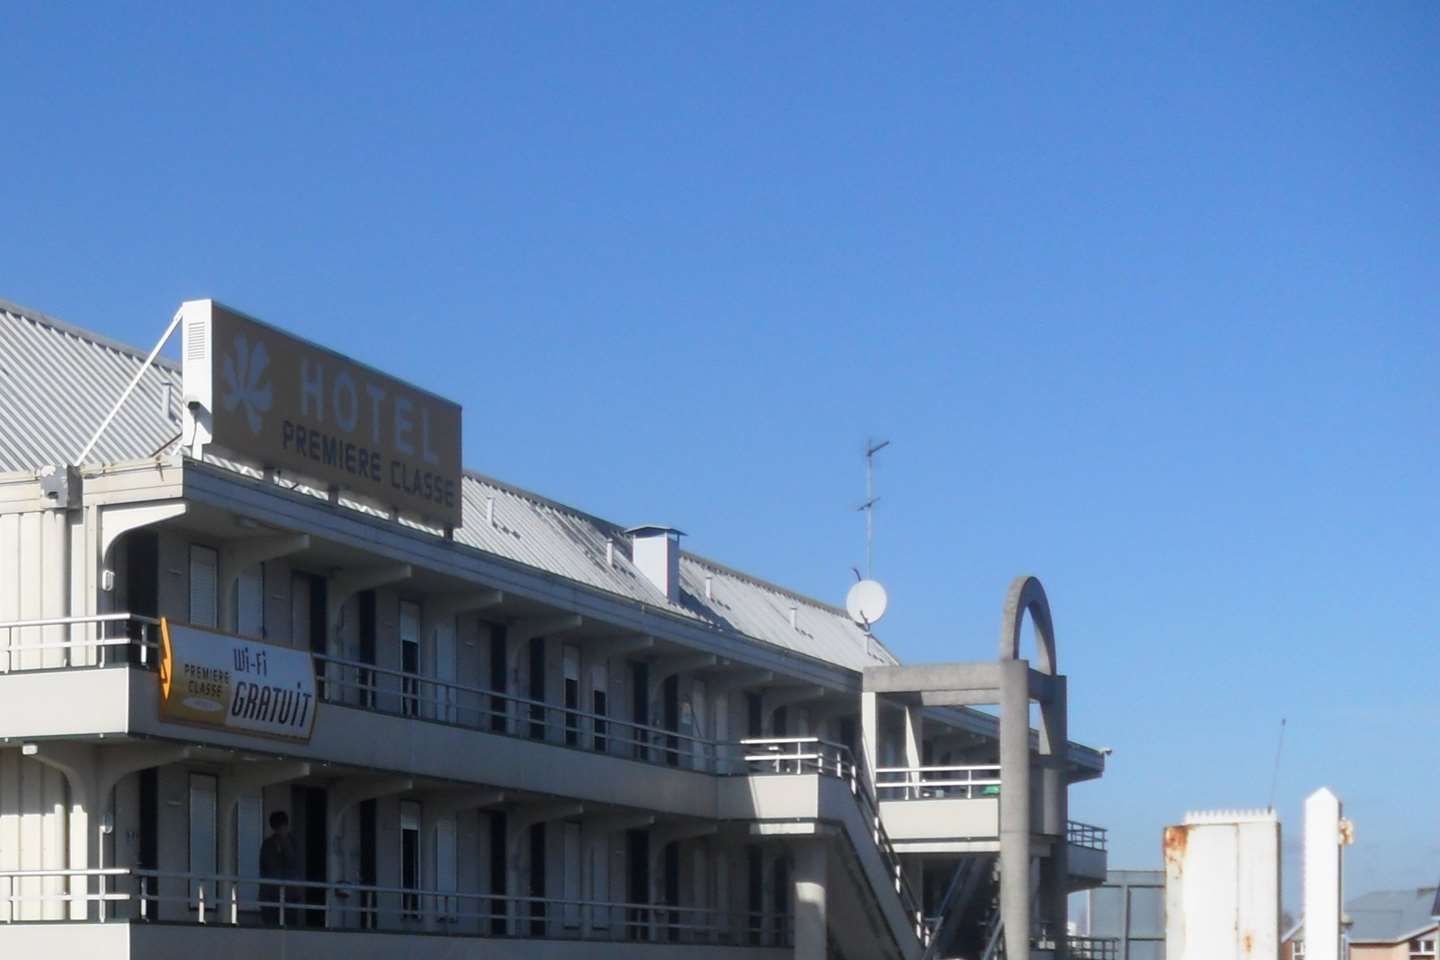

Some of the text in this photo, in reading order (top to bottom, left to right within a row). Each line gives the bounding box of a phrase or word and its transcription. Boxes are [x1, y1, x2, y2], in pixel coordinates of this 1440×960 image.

[299, 356, 439, 465] HOTEL
[281, 420, 456, 508] PREMIERE CLASSE
[184, 663, 230, 684] PREMIERE
[188, 680, 223, 697] CLASSE
